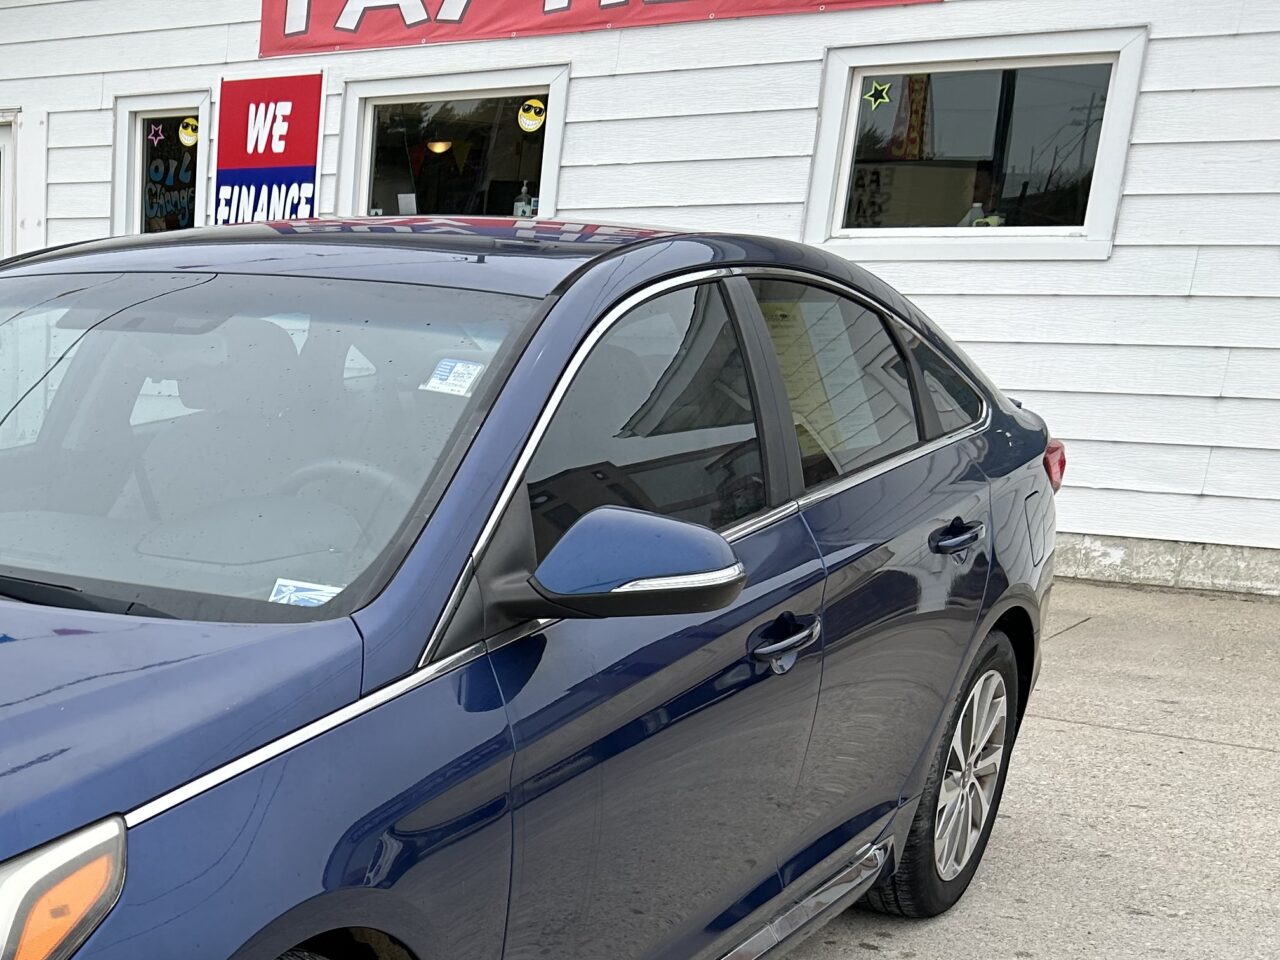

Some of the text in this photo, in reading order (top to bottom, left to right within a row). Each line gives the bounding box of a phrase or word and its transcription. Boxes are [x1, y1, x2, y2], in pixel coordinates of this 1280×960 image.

[246, 101, 293, 155] WE
[149, 151, 192, 186] OIL
[217, 182, 314, 225] FINANCE
